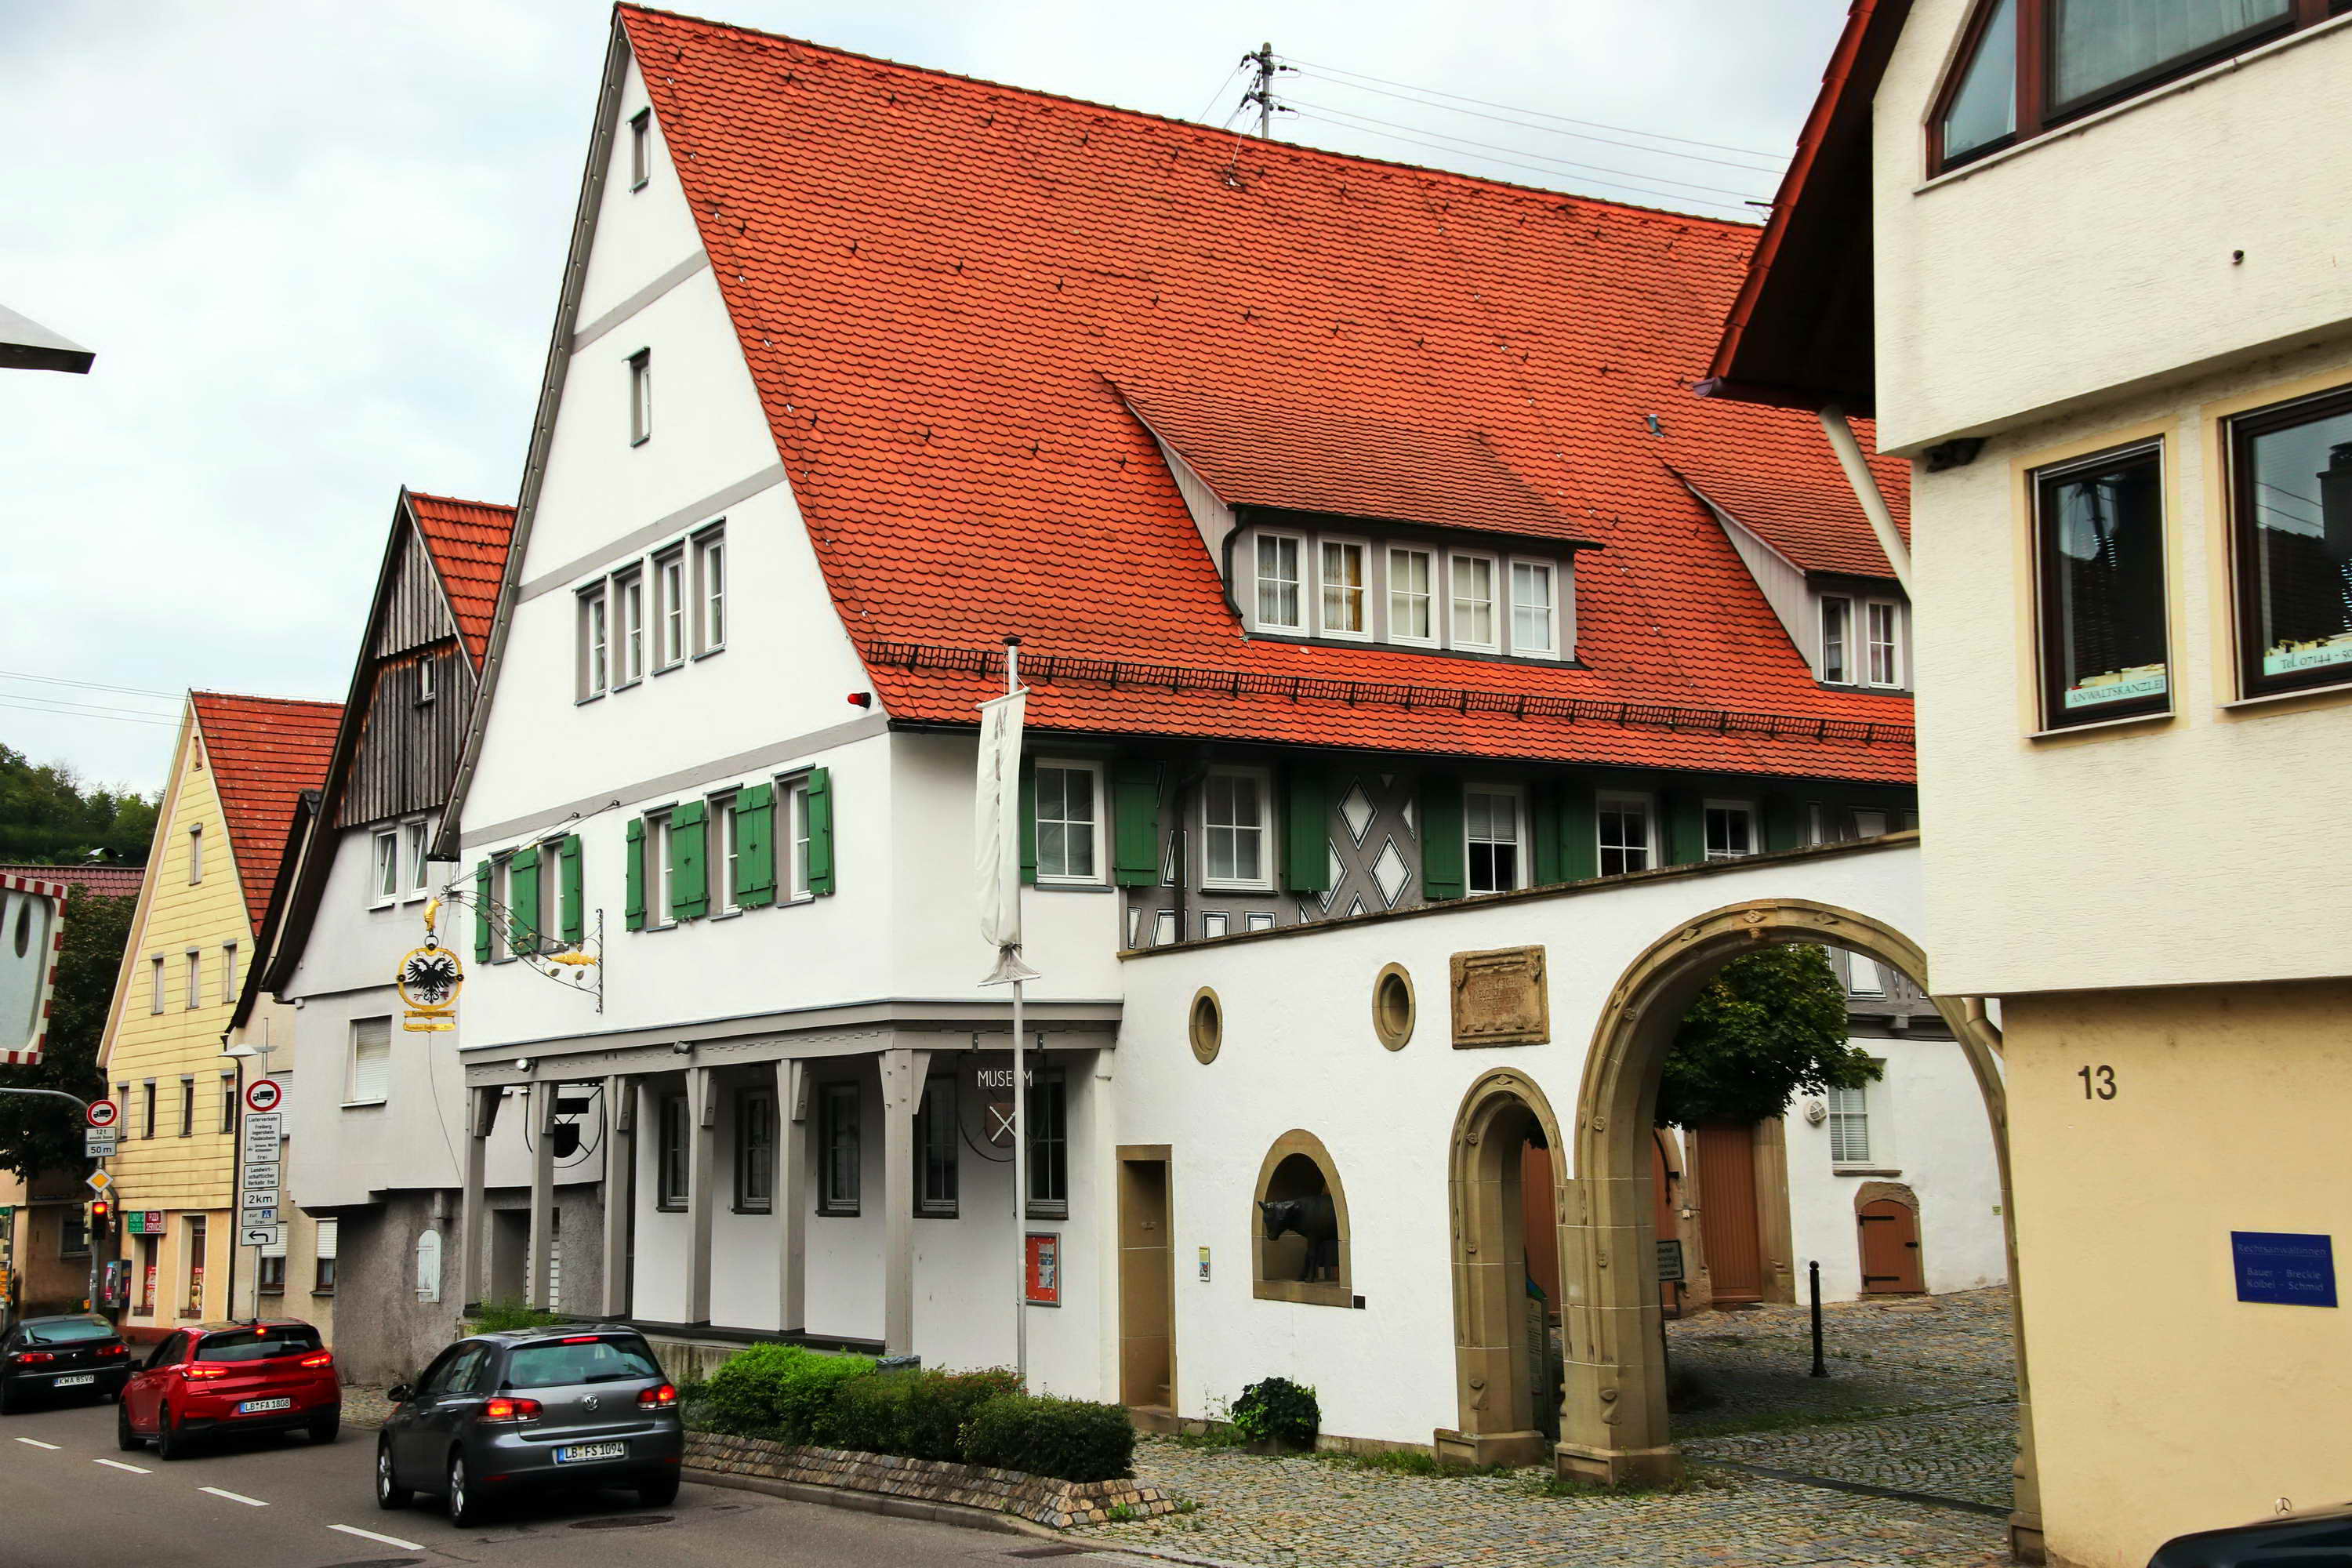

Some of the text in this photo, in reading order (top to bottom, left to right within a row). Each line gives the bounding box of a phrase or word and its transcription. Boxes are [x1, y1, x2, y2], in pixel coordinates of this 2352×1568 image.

[2300, 653, 2331, 666] 07144
[2071, 678, 2165, 703] ANWALTSKANZLEI
[978, 1069, 1033, 1087] MUSEM
[2078, 1065, 2117, 1100] 13
[2288, 1280, 2325, 1292] Schmid
[245, 1403, 256, 1411] LB
[260, 1401, 270, 1410] FA
[565, 1447, 578, 1459] LB
[585, 1446, 597, 1457] FS
[599, 1443, 623, 1455] 1094
